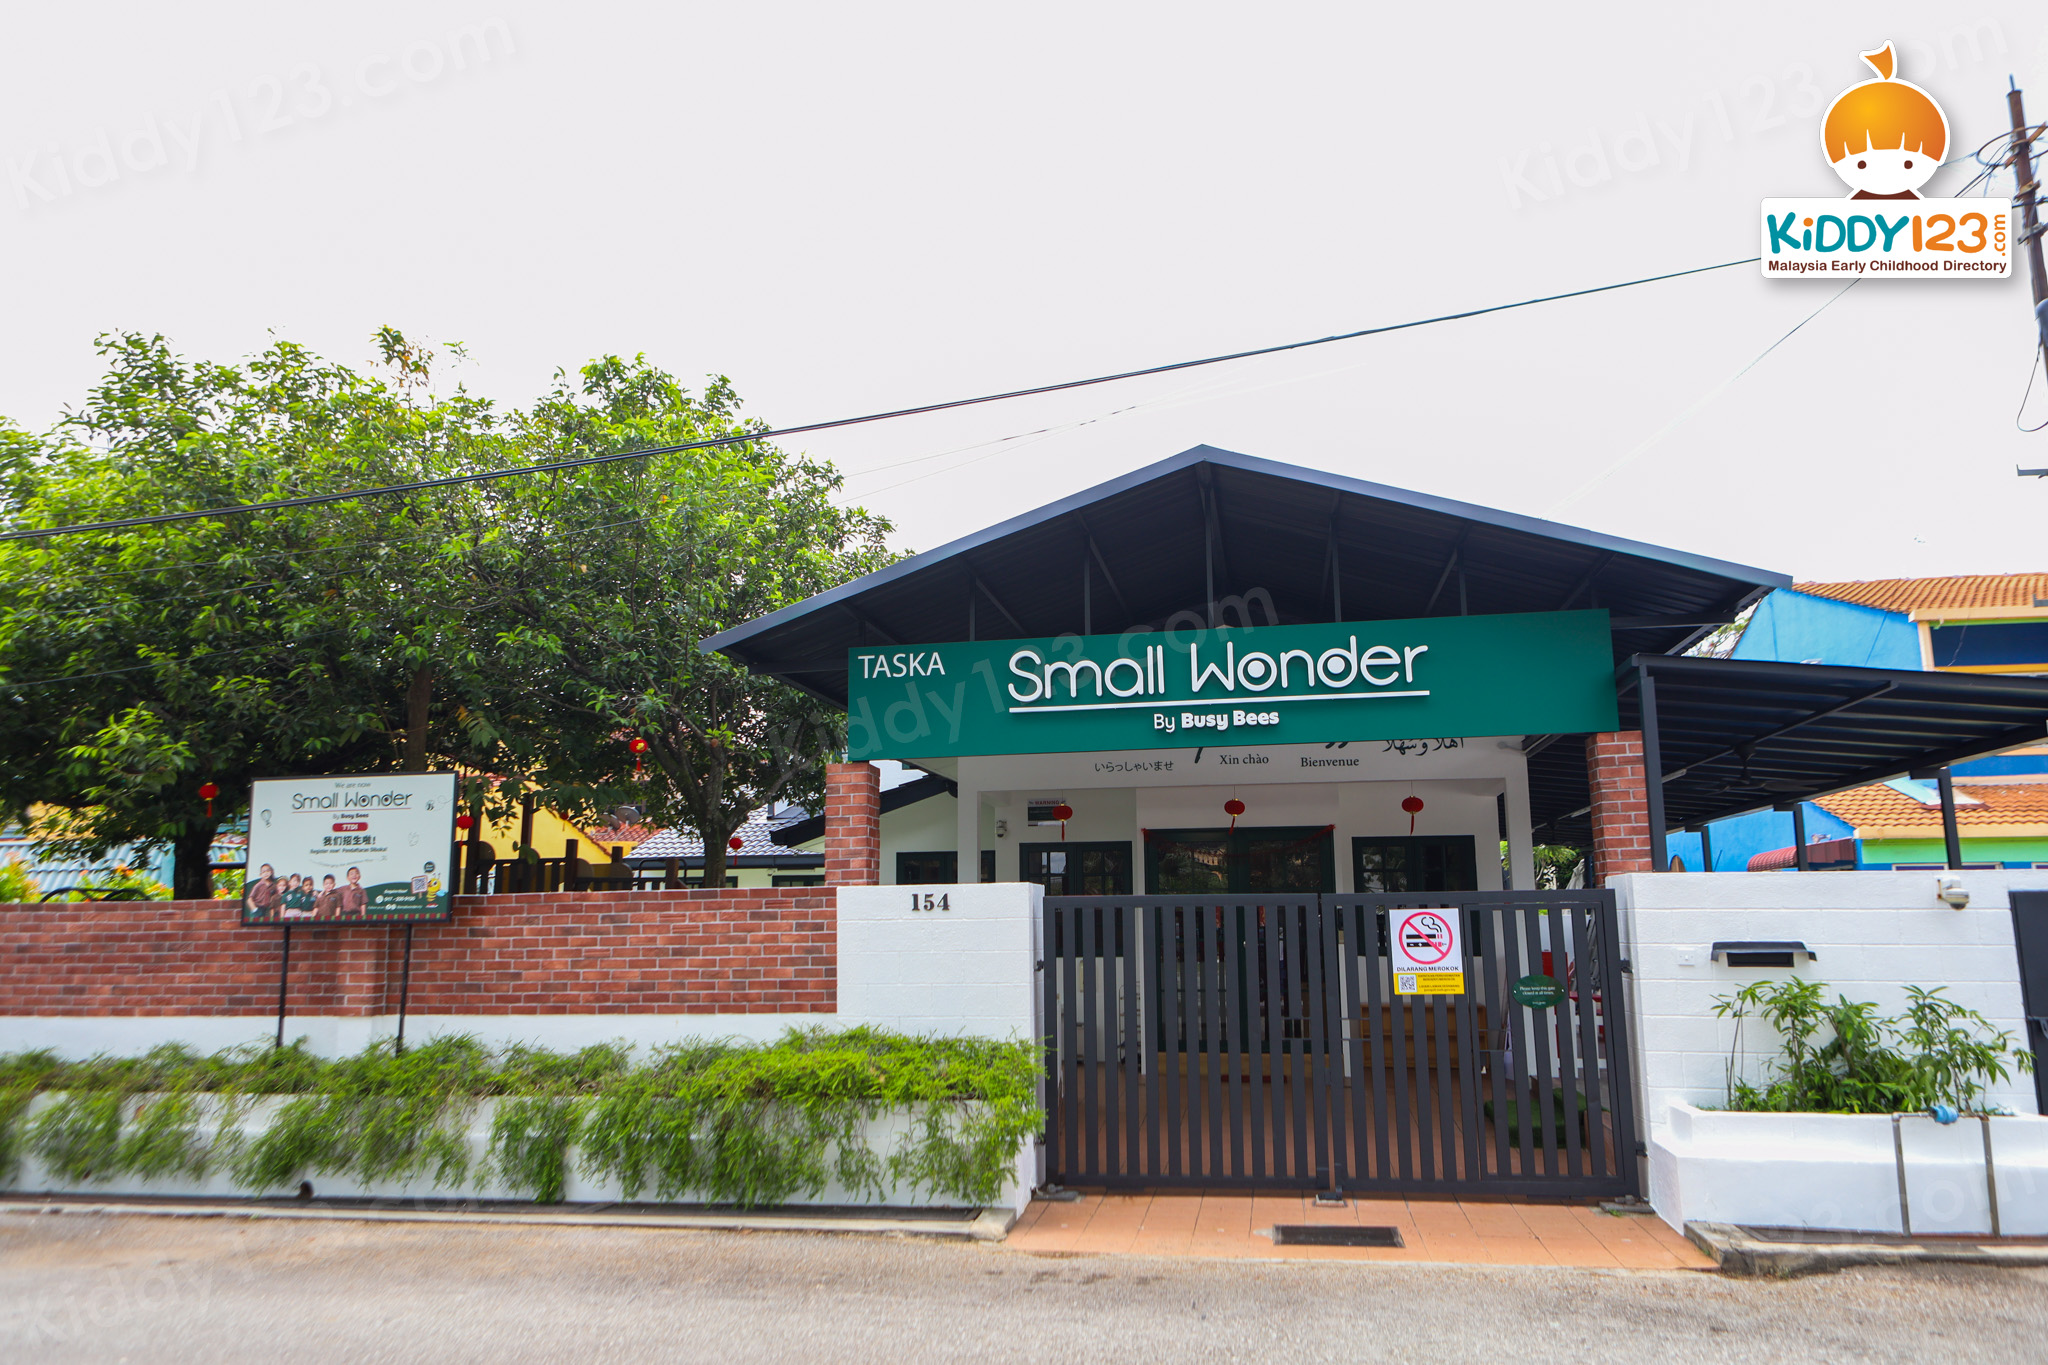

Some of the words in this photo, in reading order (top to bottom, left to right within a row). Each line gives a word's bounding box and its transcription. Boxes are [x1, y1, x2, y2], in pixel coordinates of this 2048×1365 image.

[857, 650, 946, 680] TASKA
[1007, 643, 1165, 703] Small
[1189, 634, 1430, 694] Wonder
[1153, 713, 1176, 733] By
[1180, 711, 1229, 731] Busy
[1232, 709, 1280, 726] Bees
[1094, 760, 1175, 773] いらっしゃいませ
[1219, 754, 1240, 765] Xin
[1242, 753, 1270, 765] chào
[1300, 756, 1360, 768] Bienvenue
[291, 792, 339, 810] Small
[344, 790, 413, 808] Wonder
[911, 892, 951, 912] 154
